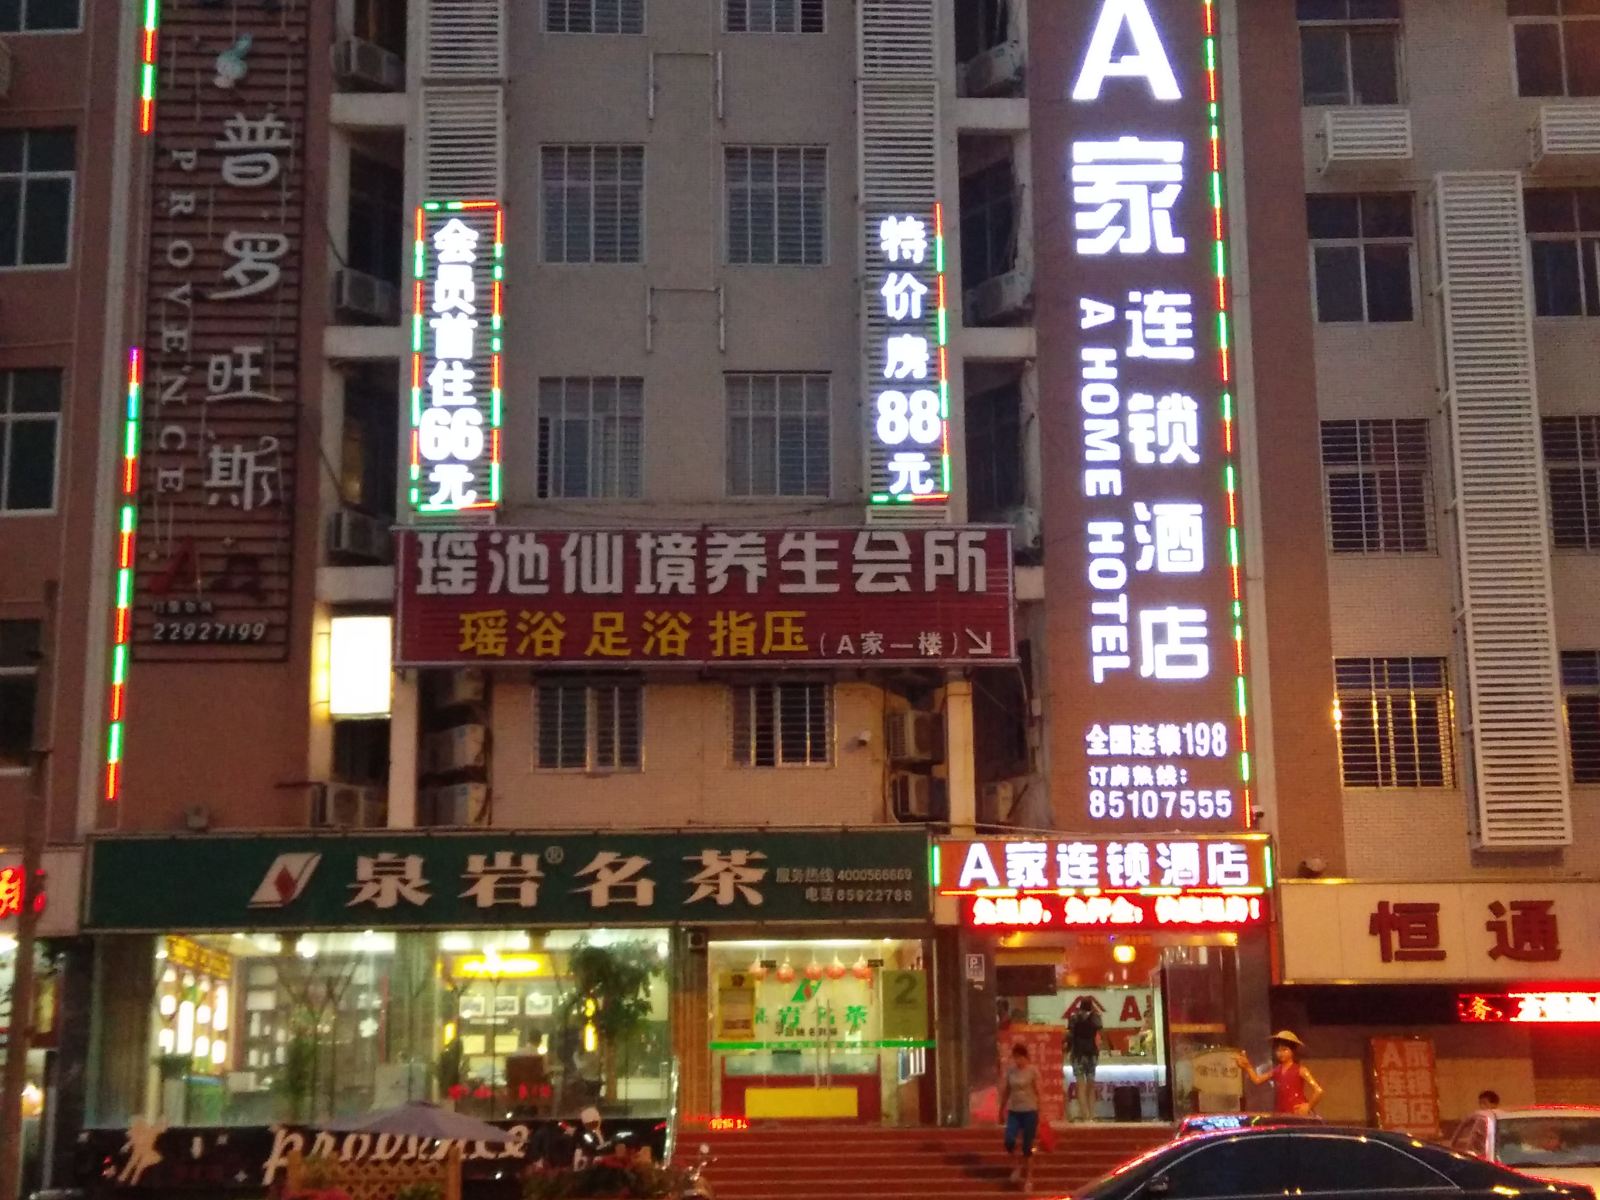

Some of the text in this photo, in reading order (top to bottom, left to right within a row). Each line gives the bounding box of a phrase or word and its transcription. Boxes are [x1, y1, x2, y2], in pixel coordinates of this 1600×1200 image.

[157, 149, 197, 493] PROVENCE
[205, 112, 292, 511] 普罗旺斯
[876, 215, 942, 494] 特价房88元
[1080, 298, 1130, 683] A HOME HOTEL
[415, 531, 988, 596] 瑶池仙境养生会所
[458, 609, 567, 657] 瑶浴
[585, 609, 690, 657] 足浴
[709, 607, 810, 656] 指压
[1089, 789, 1233, 819] 85107555
[346, 850, 771, 910] 泉岩名茶
[959, 842, 1250, 887] A家连锁酒店
[1369, 900, 1562, 963] 恒通
